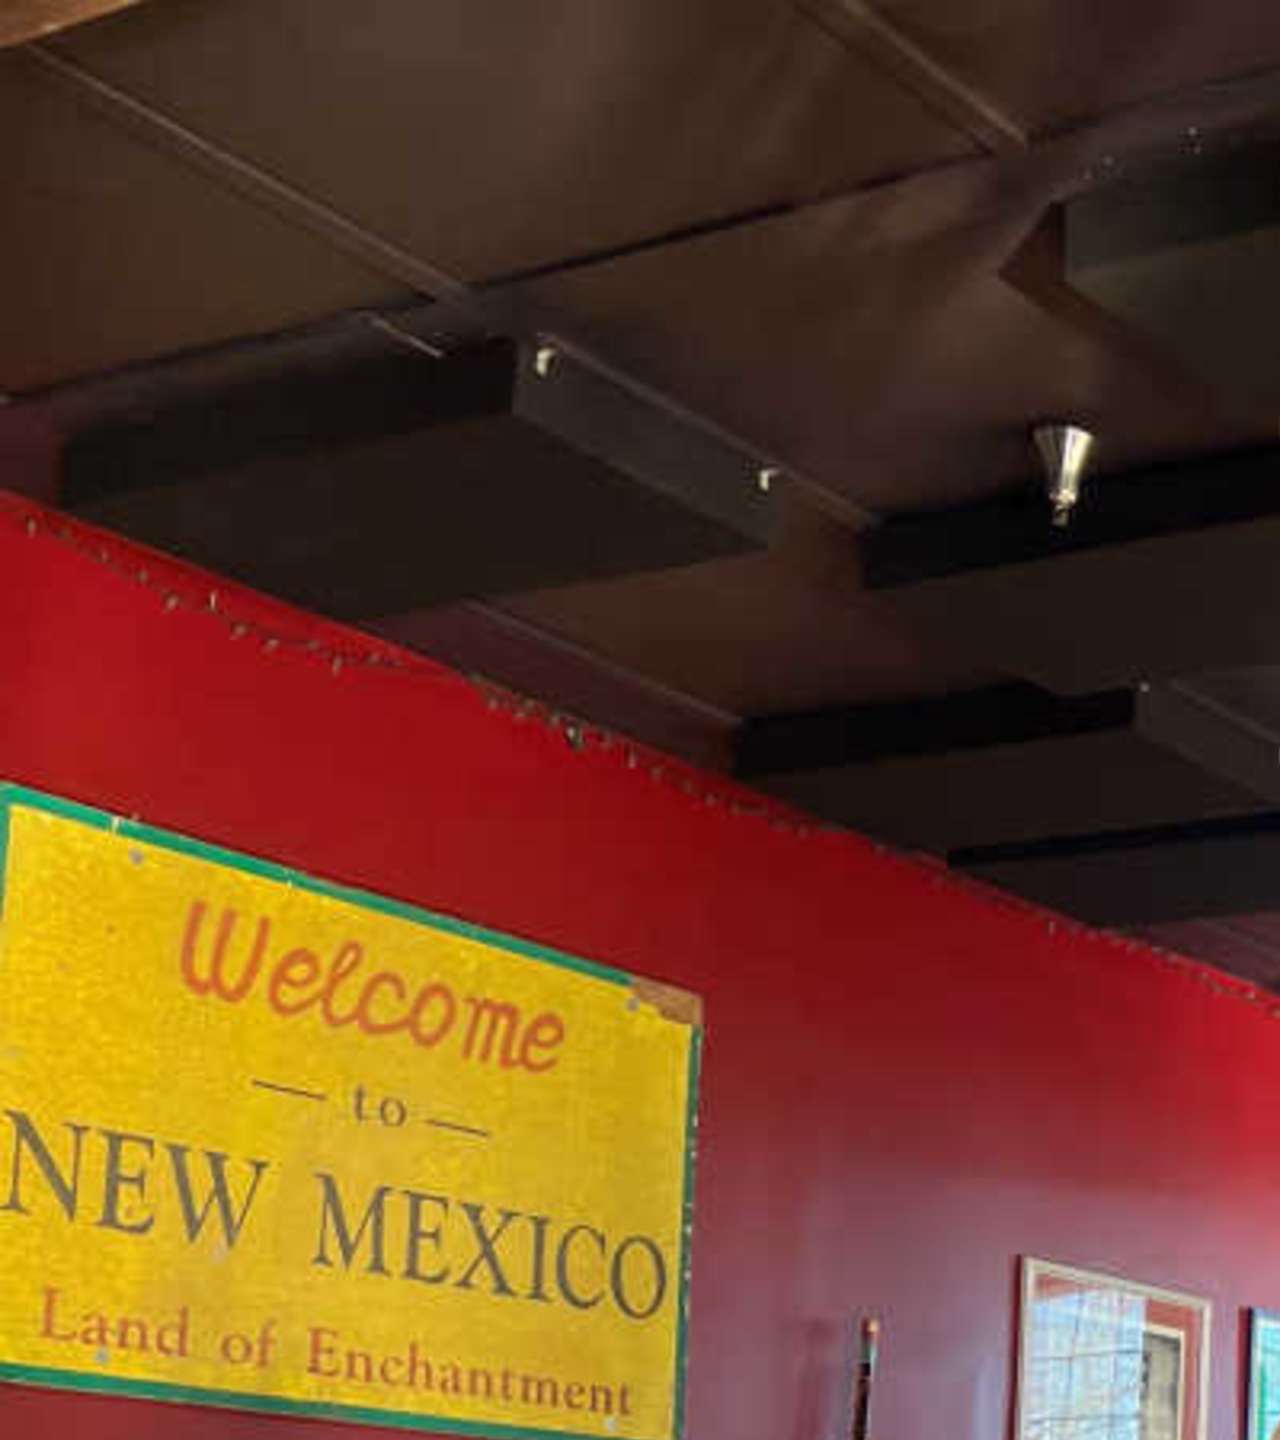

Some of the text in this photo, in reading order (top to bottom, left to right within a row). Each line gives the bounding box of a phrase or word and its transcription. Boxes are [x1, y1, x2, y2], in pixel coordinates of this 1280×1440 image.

[180, 900, 566, 1073] Welcome
[352, 1083, 407, 1127] to
[0, 1108, 668, 1320] NEW MEXICO
[38, 1287, 633, 1417] Land of Enchantment
